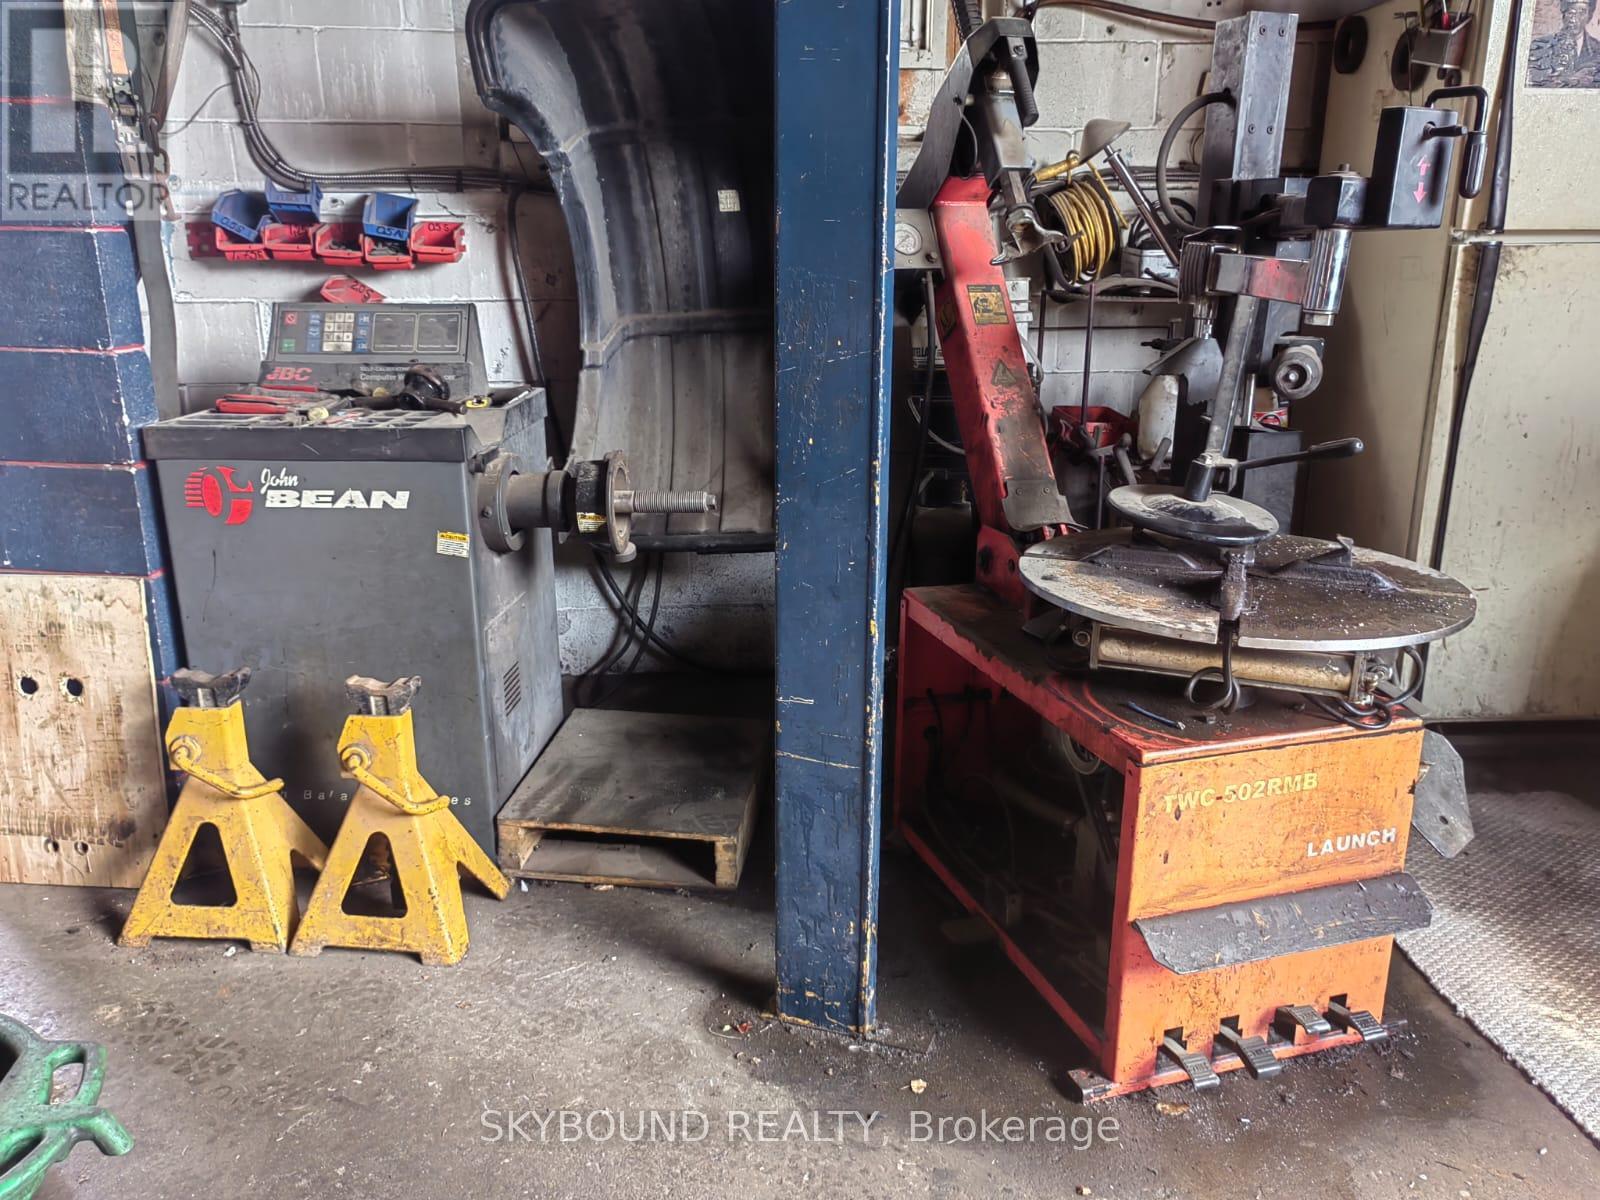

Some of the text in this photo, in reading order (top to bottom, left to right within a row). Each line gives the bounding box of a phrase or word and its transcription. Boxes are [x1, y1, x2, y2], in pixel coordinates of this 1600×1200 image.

[266, 367, 312, 381] JBC
[260, 467, 299, 494] John
[265, 488, 410, 509] BEAN
[1163, 773, 1319, 814] TWC-502RMB
[1307, 827, 1397, 858] LAUNCH
